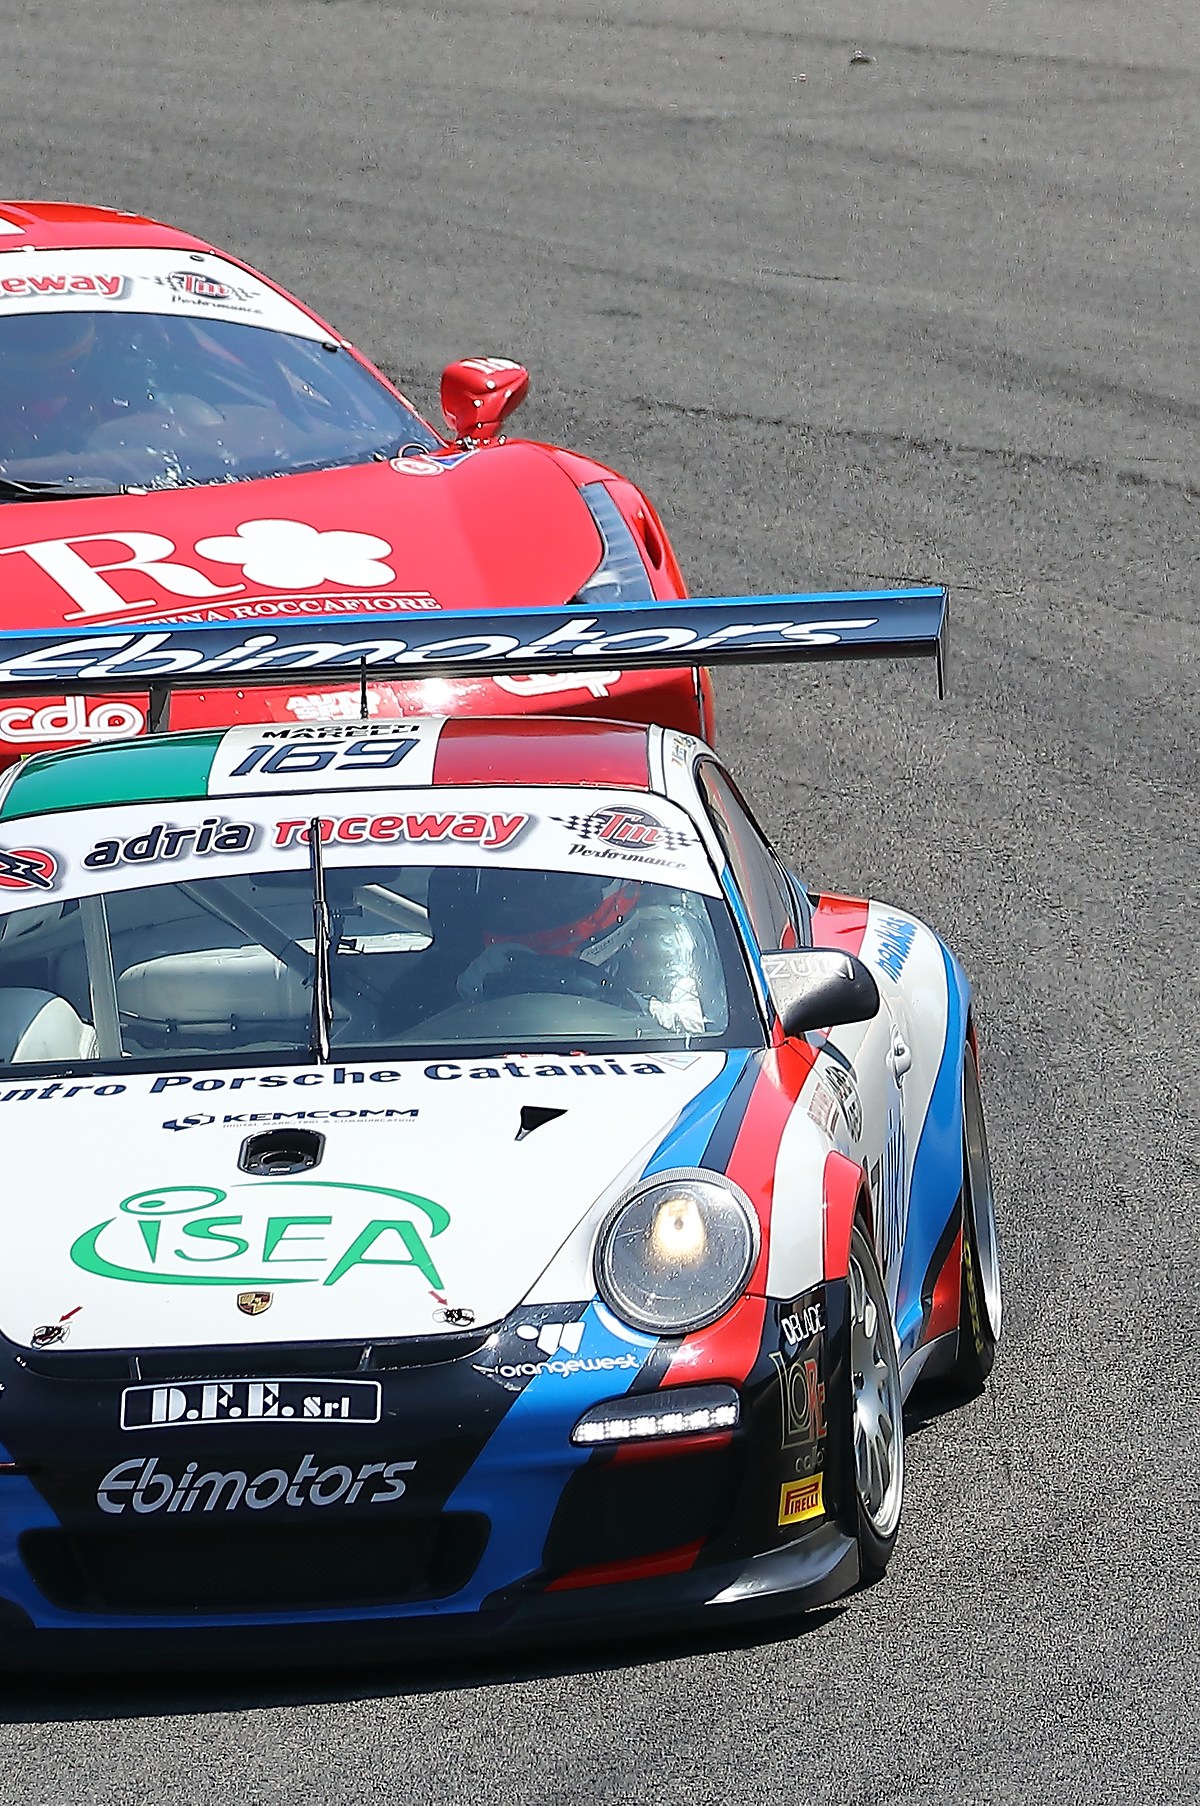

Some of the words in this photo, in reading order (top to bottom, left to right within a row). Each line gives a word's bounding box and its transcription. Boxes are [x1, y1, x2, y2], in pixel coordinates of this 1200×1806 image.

[229, 597, 442, 619] ROCCAFIORE
[229, 738, 421, 777] 169
[86, 816, 250, 867] adria
[272, 812, 524, 848] raceway
[568, 844, 688, 870] Performance
[149, 1067, 402, 1095] Porsche
[423, 1058, 666, 1081] Catania
[223, 1108, 420, 1123] KEMCOMM
[781, 1303, 826, 1346] DBLADE
[499, 1353, 641, 1379] orangewest
[152, 1382, 294, 1423] D.F.E.
[303, 1396, 350, 1419] Srl
[97, 1454, 417, 1514] Ebimotors
[784, 1480, 820, 1516] PIRELLI
